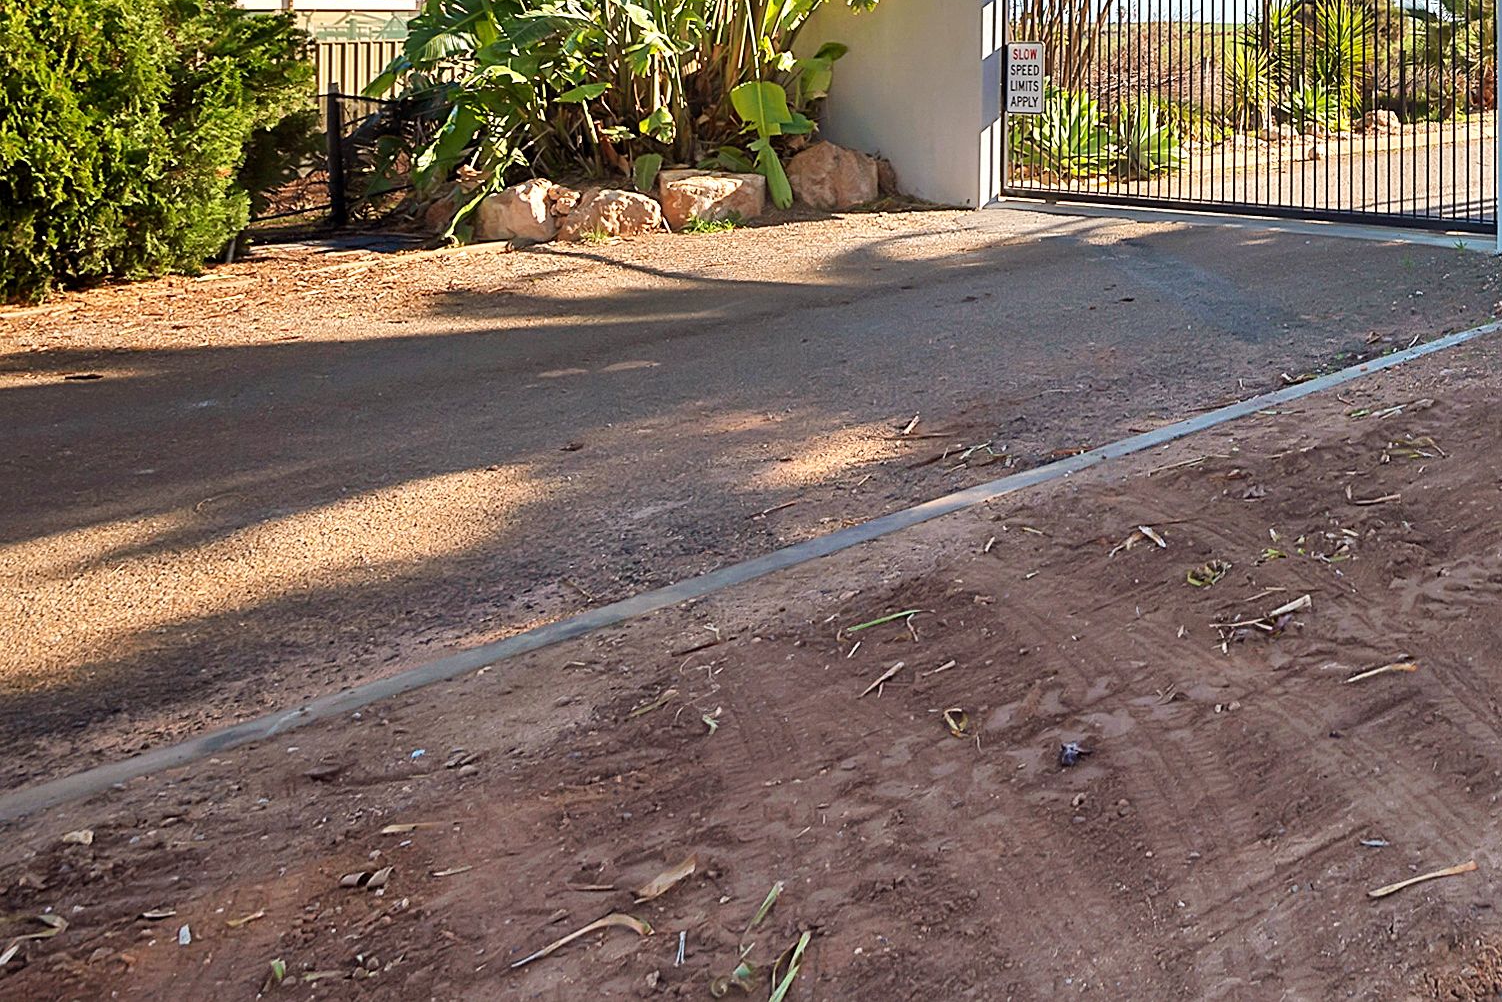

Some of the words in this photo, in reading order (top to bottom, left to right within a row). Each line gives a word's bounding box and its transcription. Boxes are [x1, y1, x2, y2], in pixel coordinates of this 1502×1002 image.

[1012, 48, 1037, 60] SLOW
[1010, 64, 1040, 76] SPEED
[1010, 80, 1039, 92] LIMITS
[1010, 96, 1039, 108] APPLY
